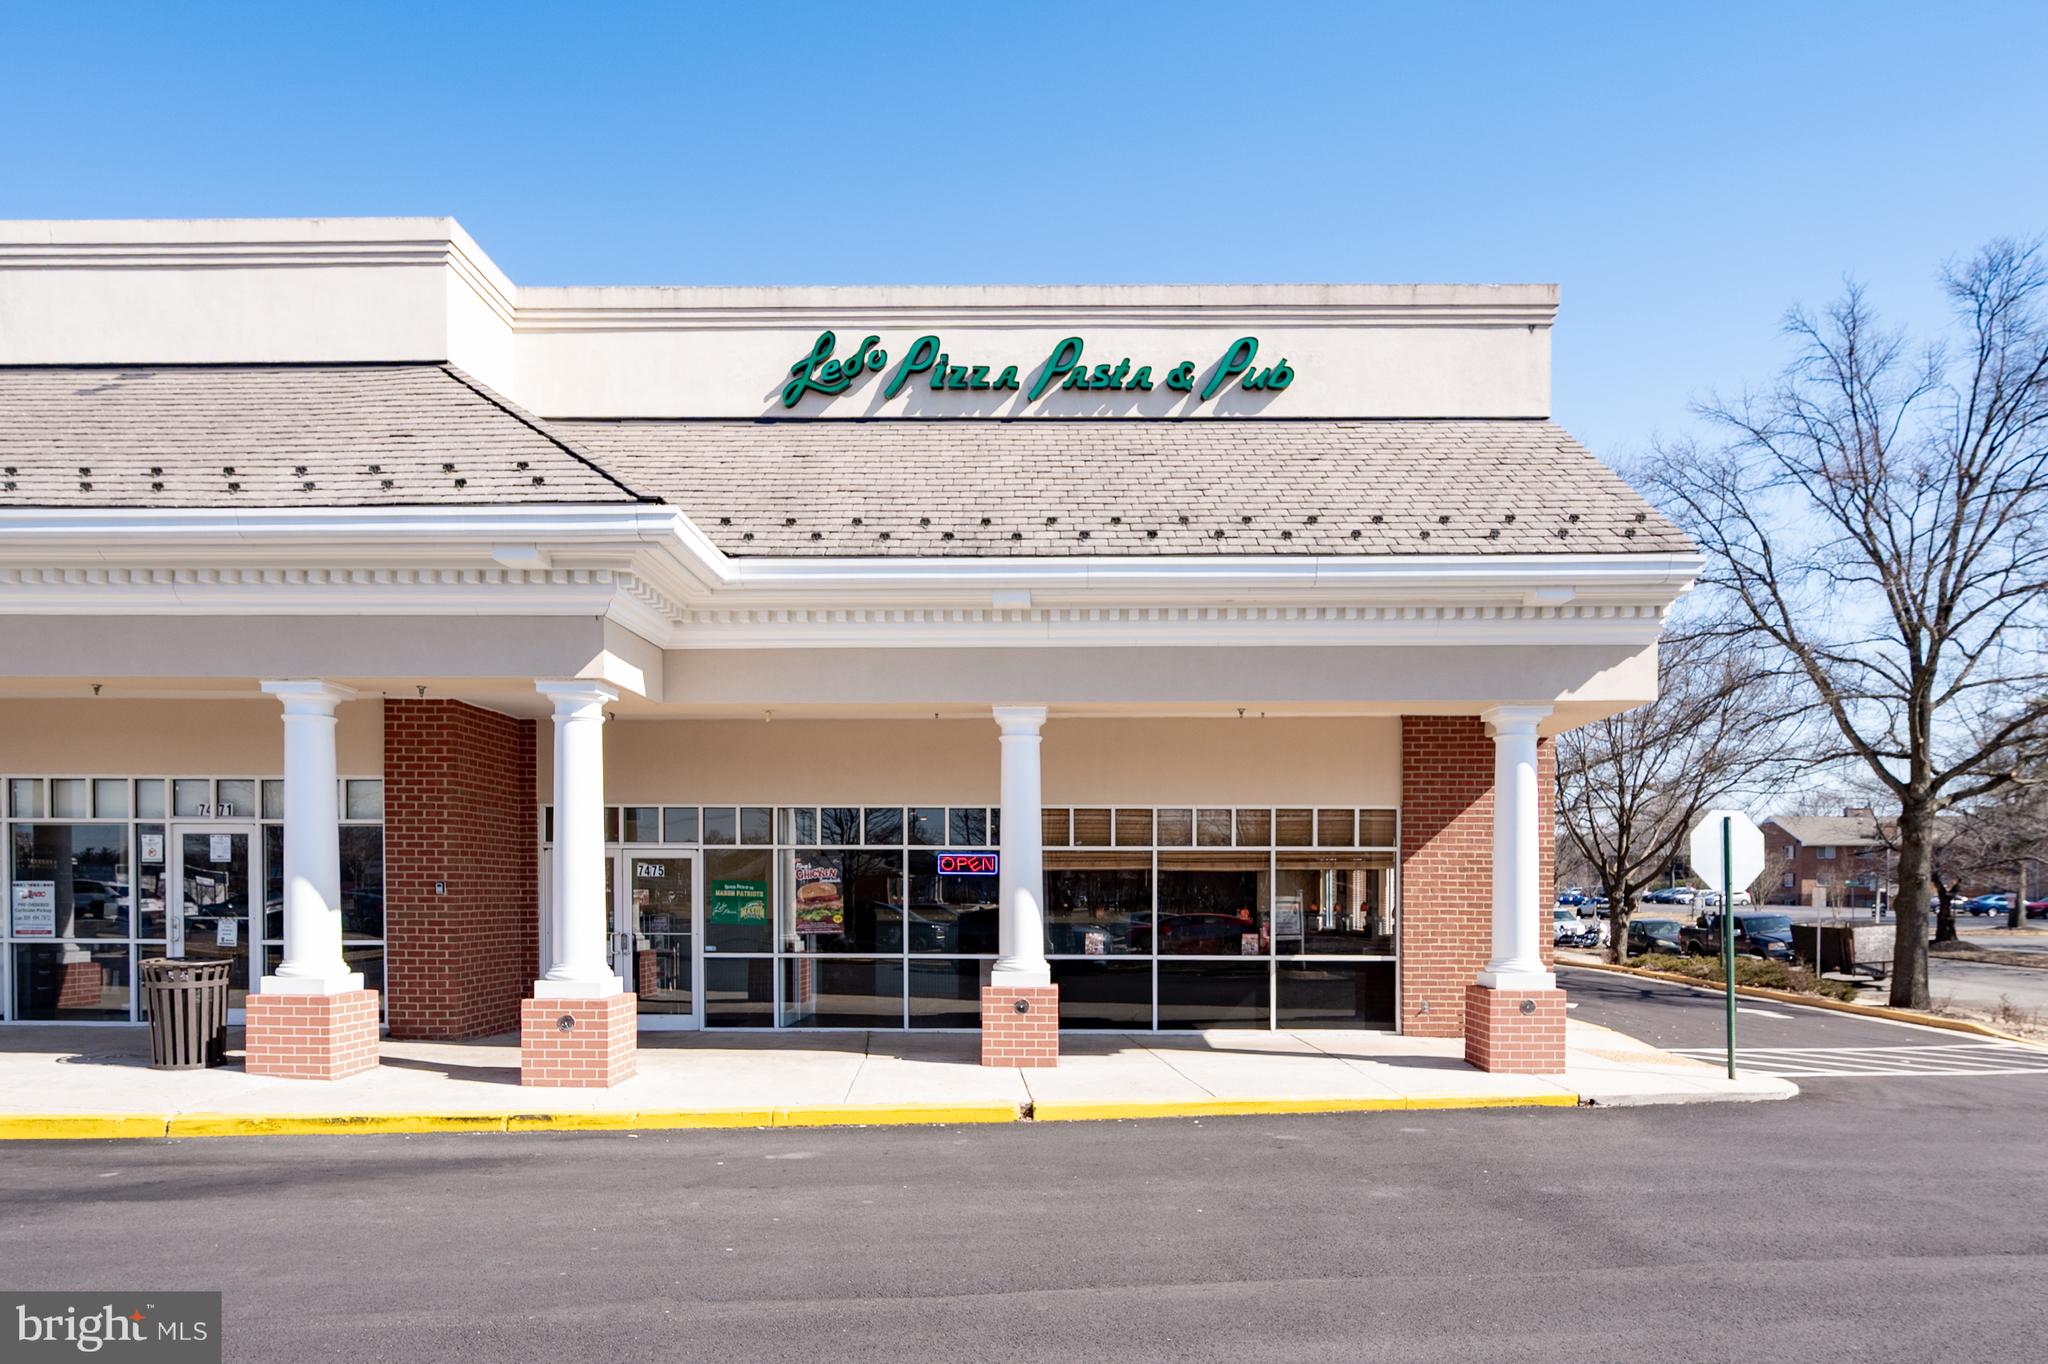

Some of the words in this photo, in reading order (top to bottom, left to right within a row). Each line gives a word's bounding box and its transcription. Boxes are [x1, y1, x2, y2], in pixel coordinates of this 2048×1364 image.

[782, 330, 888, 408] Ledo
[884, 335, 1020, 400] Pizza
[1027, 336, 1153, 402] Pasta
[1166, 361, 1195, 392] &
[1200, 336, 1295, 402] Pub
[638, 865, 665, 876] 7475
[941, 856, 994, 871] OPEN
[796, 867, 838, 880] CHICKEN
